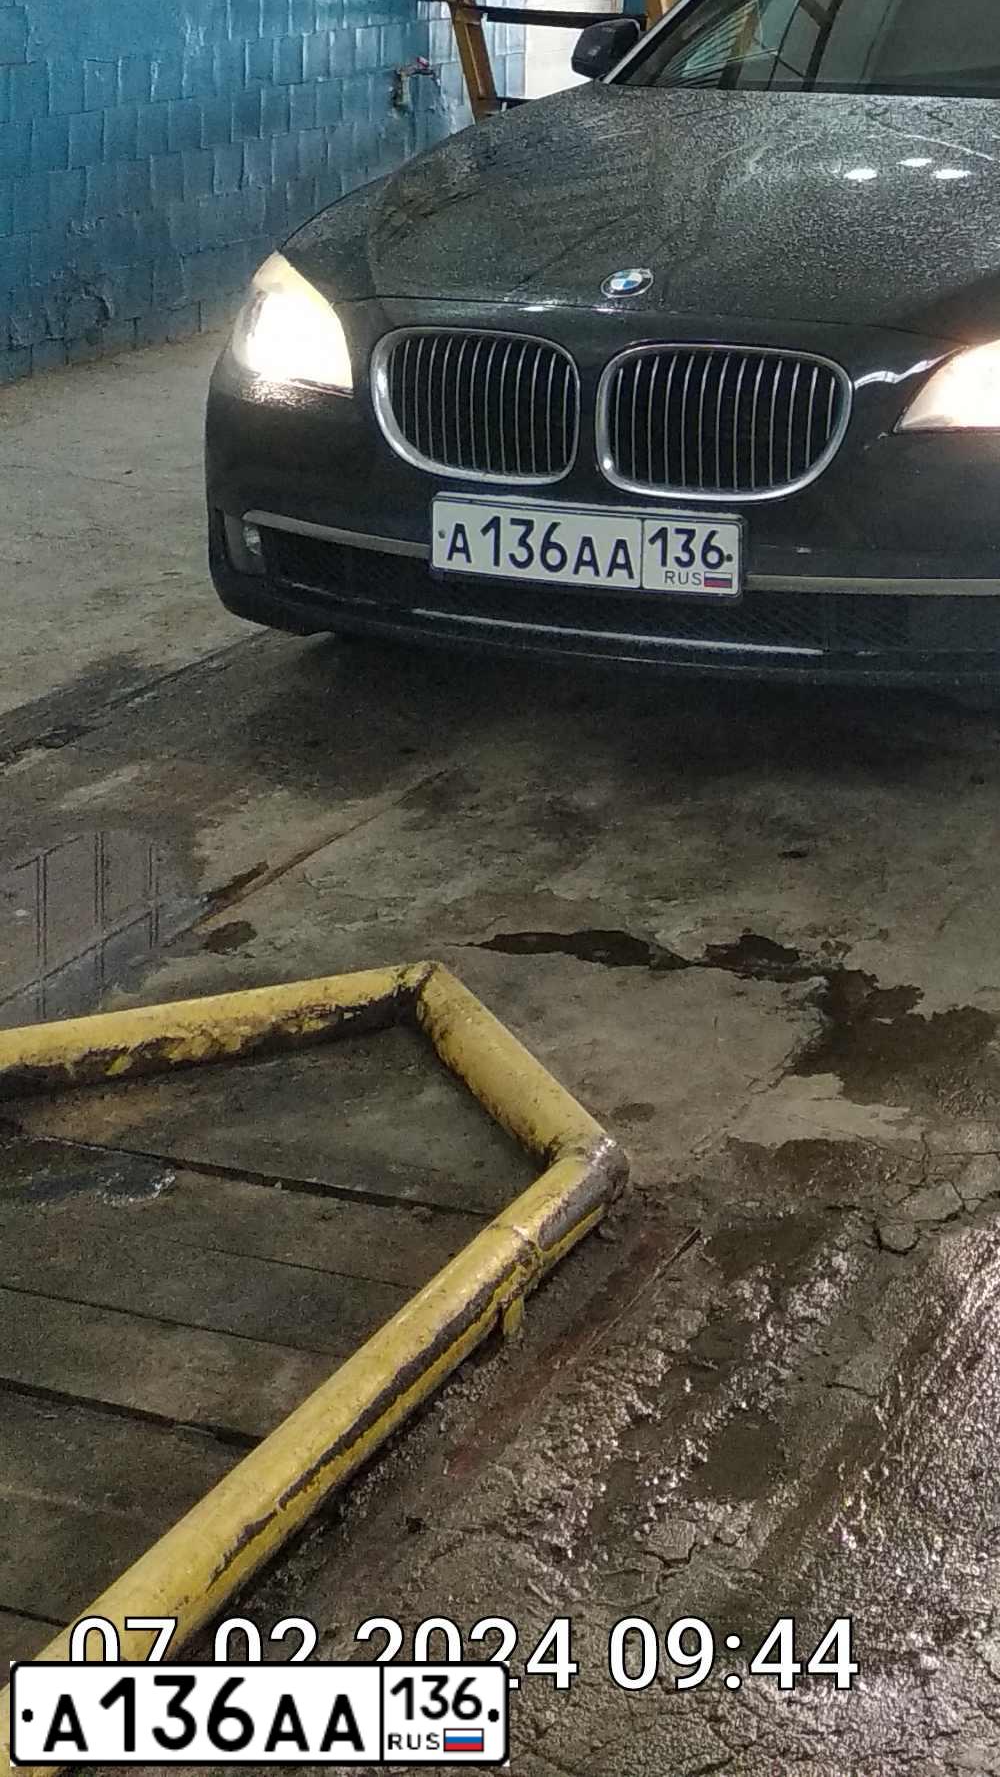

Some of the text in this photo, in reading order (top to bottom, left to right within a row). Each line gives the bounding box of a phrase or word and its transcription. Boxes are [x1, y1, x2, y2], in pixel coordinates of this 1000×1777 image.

[446, 515, 726, 580] А136АА 136
[663, 570, 703, 587] RUS
